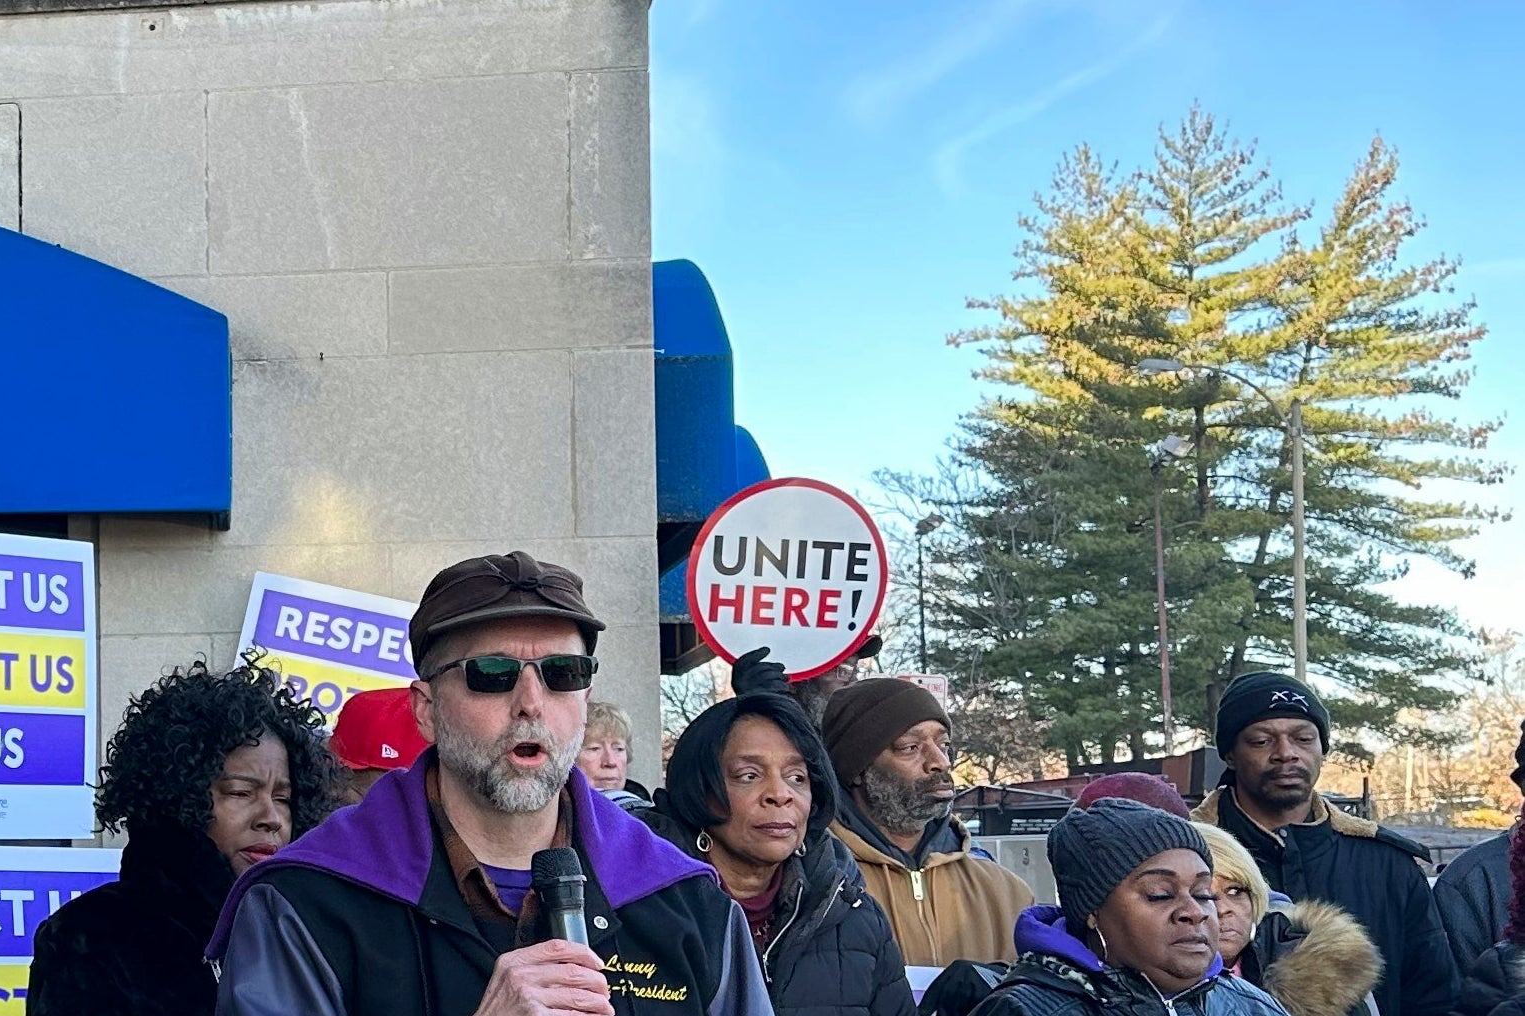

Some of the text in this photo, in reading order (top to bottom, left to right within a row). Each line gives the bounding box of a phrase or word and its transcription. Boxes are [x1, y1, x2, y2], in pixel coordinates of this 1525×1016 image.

[712, 535, 872, 582] UNITE
[22, 572, 69, 615] US
[708, 583, 863, 632] HERE!
[30, 654, 75, 693] US
